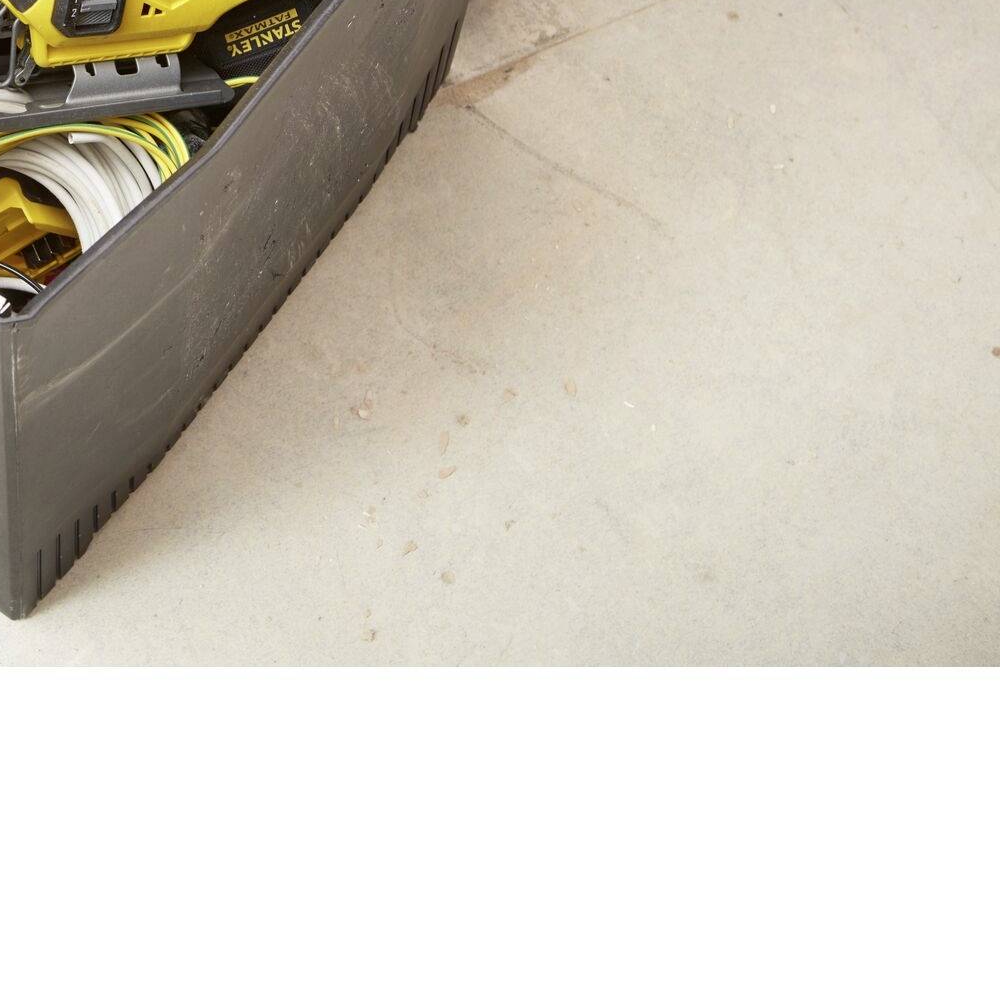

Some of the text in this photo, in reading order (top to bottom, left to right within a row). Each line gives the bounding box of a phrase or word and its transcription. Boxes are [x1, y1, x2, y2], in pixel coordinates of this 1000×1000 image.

[71, 8, 78, 18] 2
[235, 11, 291, 40] FATMAX
[231, 19, 302, 57] STANLEY
